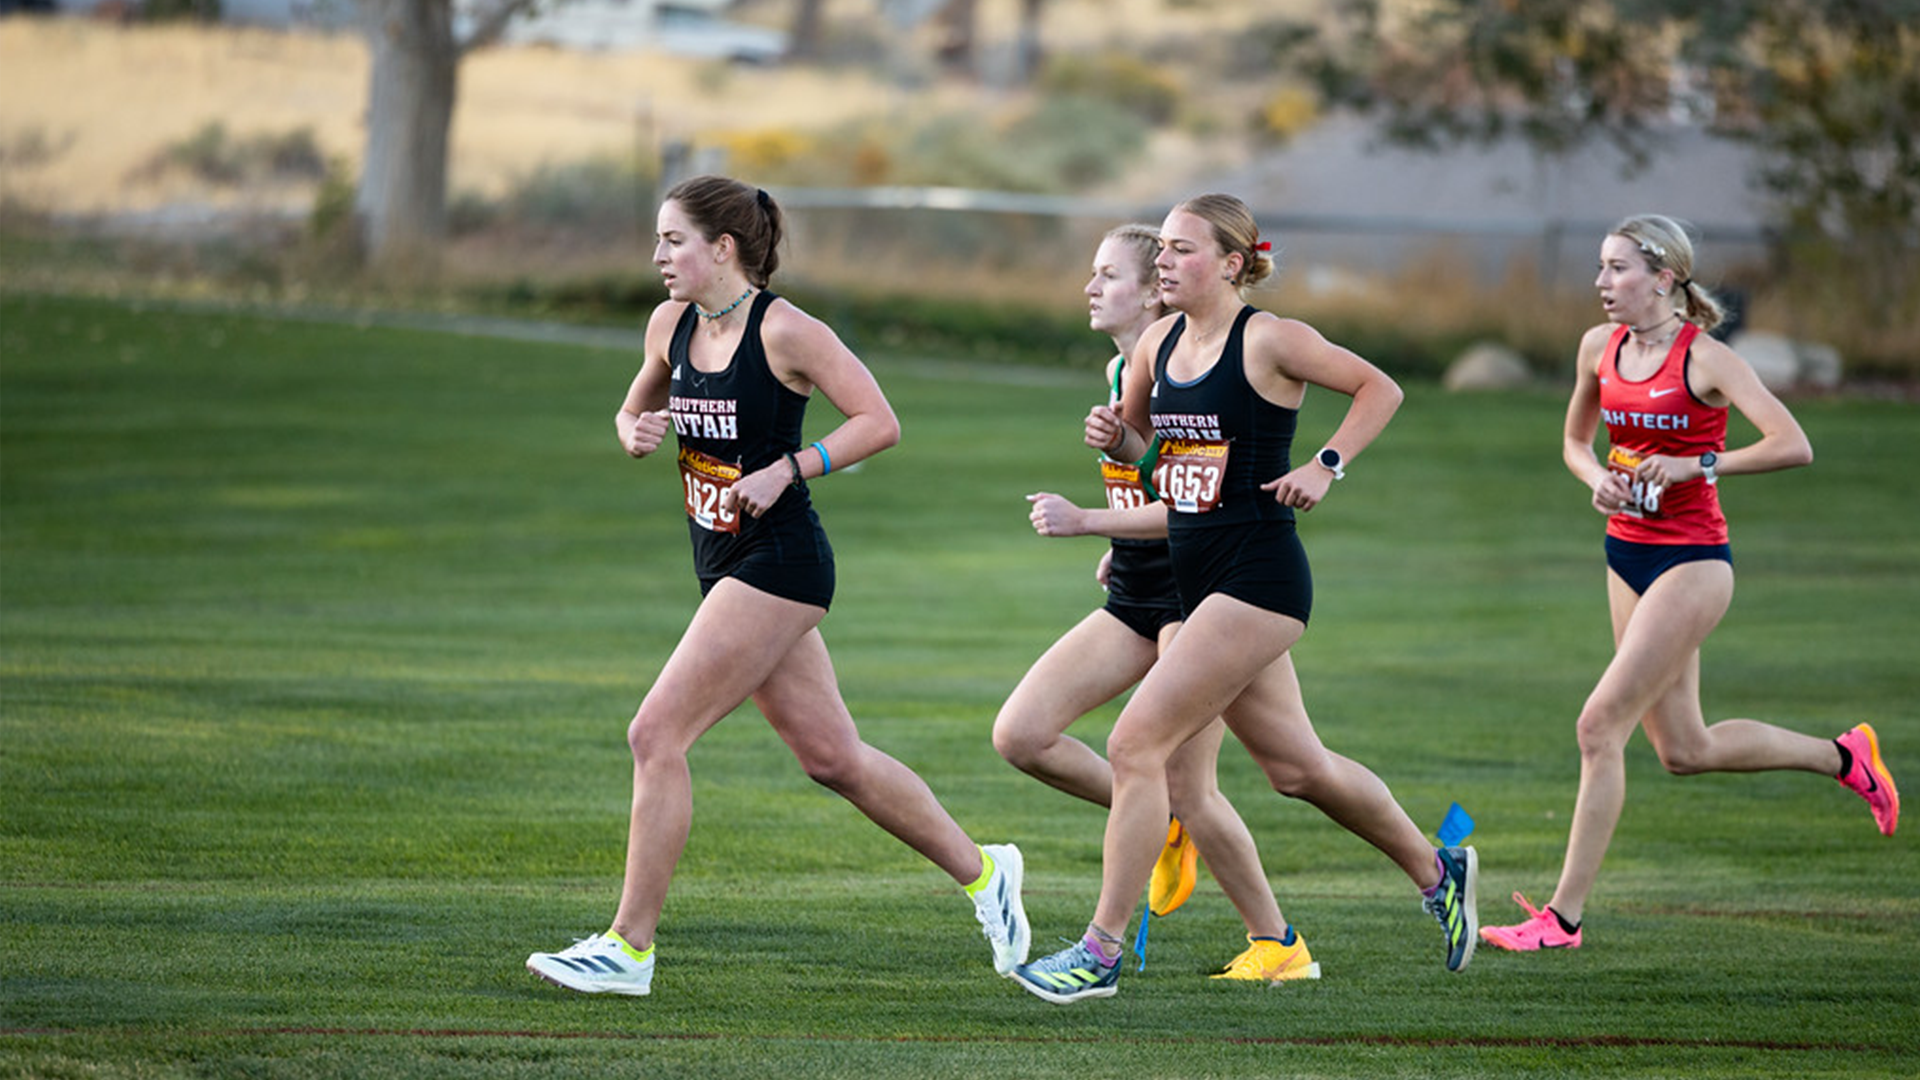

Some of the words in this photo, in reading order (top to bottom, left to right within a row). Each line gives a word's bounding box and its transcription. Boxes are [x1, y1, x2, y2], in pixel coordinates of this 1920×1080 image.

[669, 396, 737, 413] SOUTHERN
[671, 412, 738, 439] UTAH
[1628, 412, 1689, 430] TECH
[1157, 463, 1219, 502] 1653
